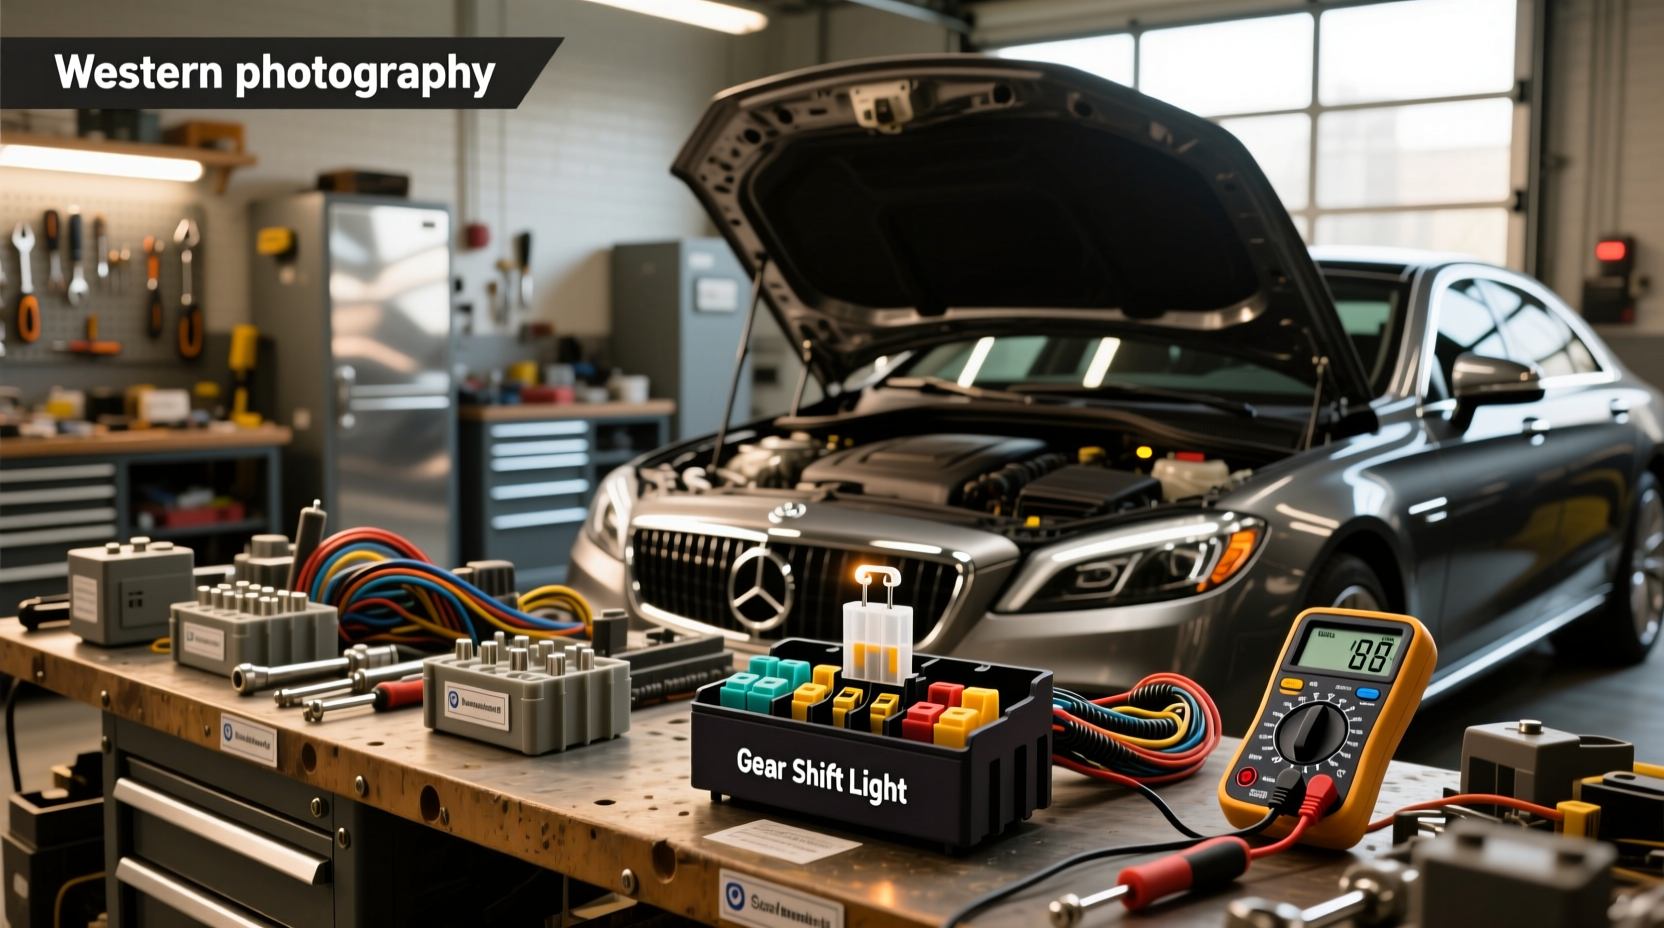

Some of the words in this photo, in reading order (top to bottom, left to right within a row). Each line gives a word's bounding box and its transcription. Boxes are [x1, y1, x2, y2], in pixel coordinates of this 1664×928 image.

[737, 747, 788, 781] Gear
[792, 758, 844, 793] Shift
[849, 768, 908, 807] Light
